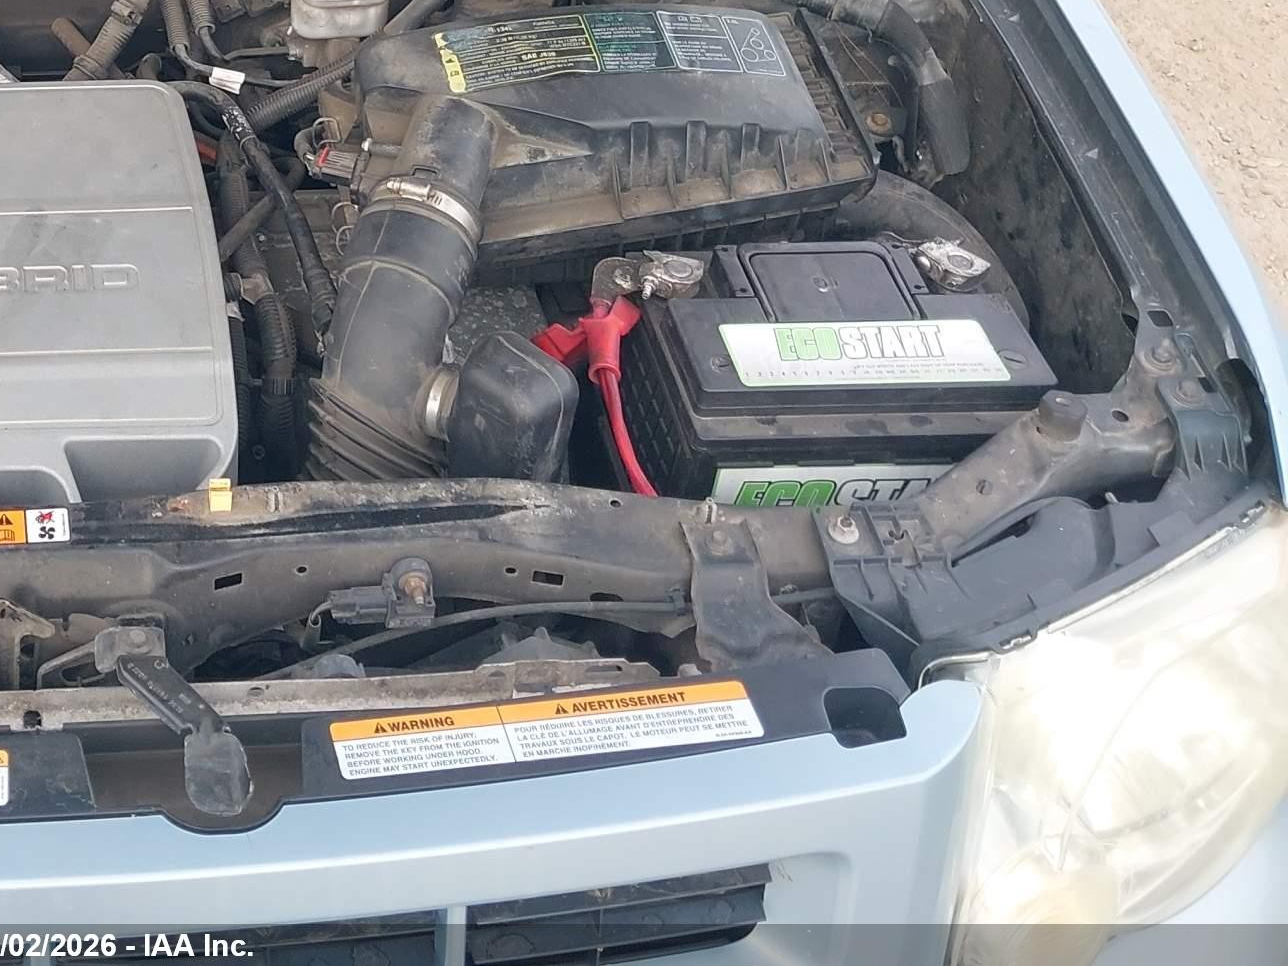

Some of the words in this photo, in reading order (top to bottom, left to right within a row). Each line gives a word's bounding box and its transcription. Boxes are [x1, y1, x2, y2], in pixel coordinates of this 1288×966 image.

[773, 324, 945, 362] ECOSTART
[572, 691, 686, 714] AVERTISSEMENT
[387, 716, 455, 733] WARNING
